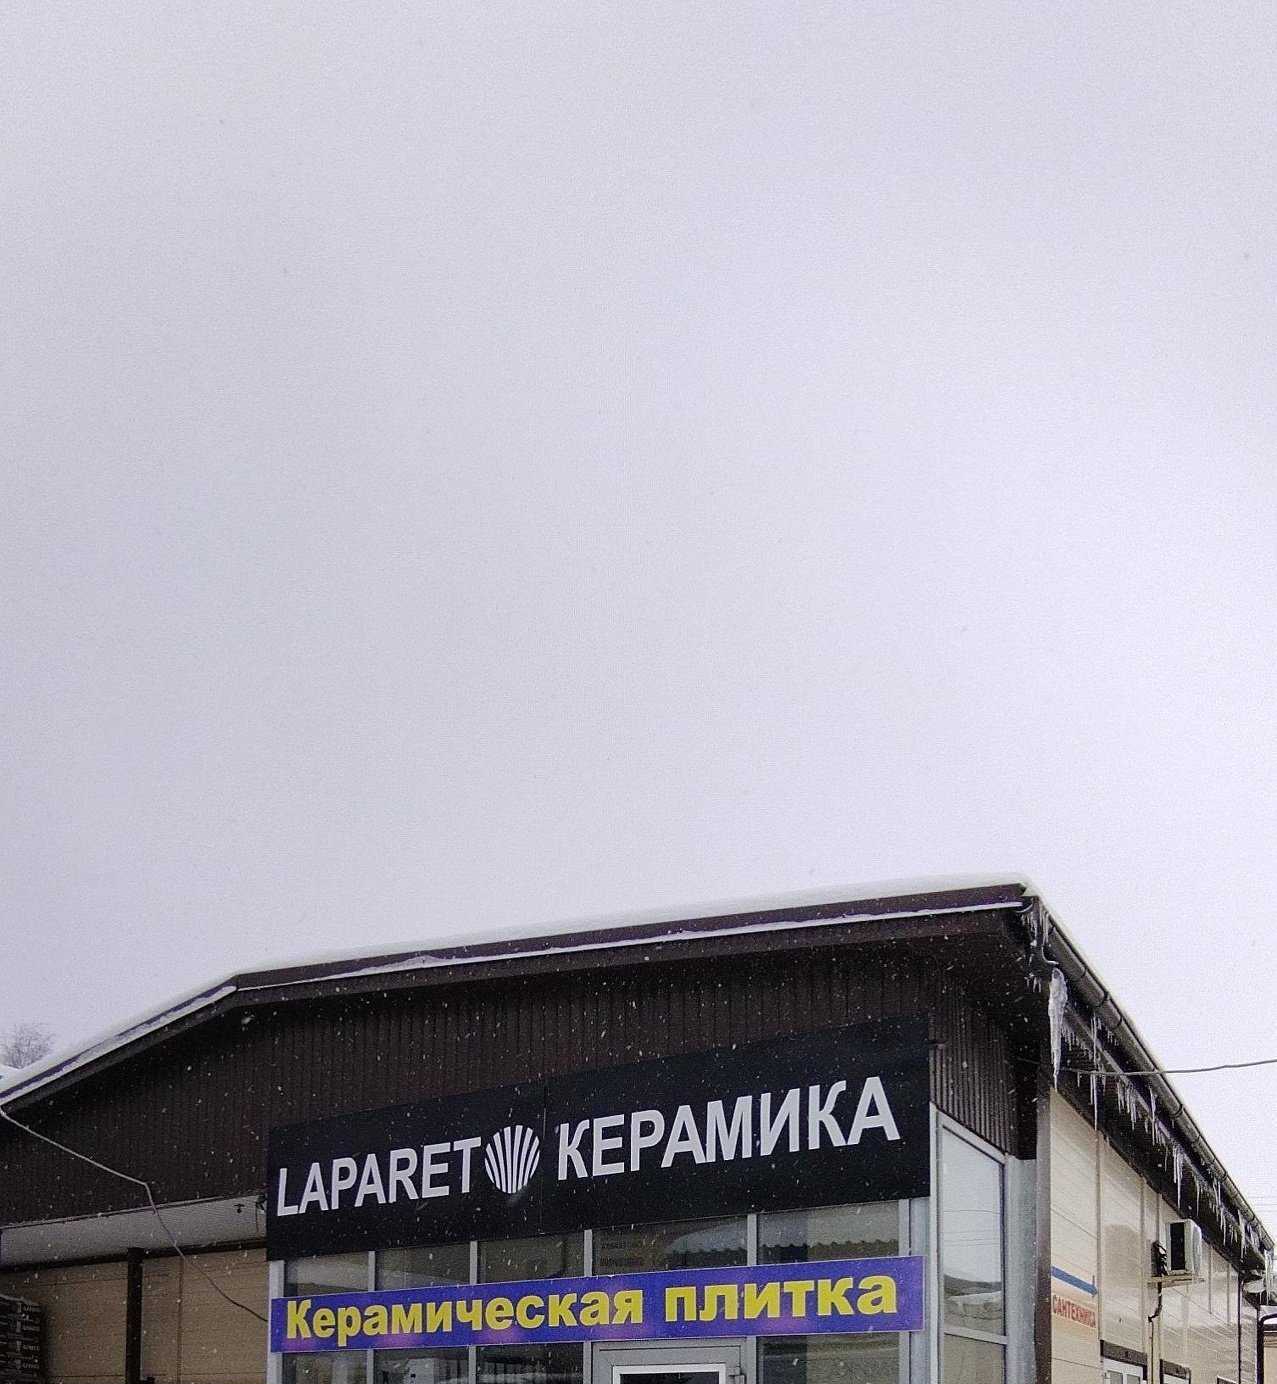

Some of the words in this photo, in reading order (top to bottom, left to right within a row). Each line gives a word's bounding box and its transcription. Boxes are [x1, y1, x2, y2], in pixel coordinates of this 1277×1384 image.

[276, 1136, 482, 1217] LAPARET
[556, 1076, 902, 1182] КЕРАМИКА
[285, 1289, 644, 1347] Керамическая
[663, 1273, 898, 1322] плитка
[1053, 1295, 1096, 1328] САНТЕХНИКА
